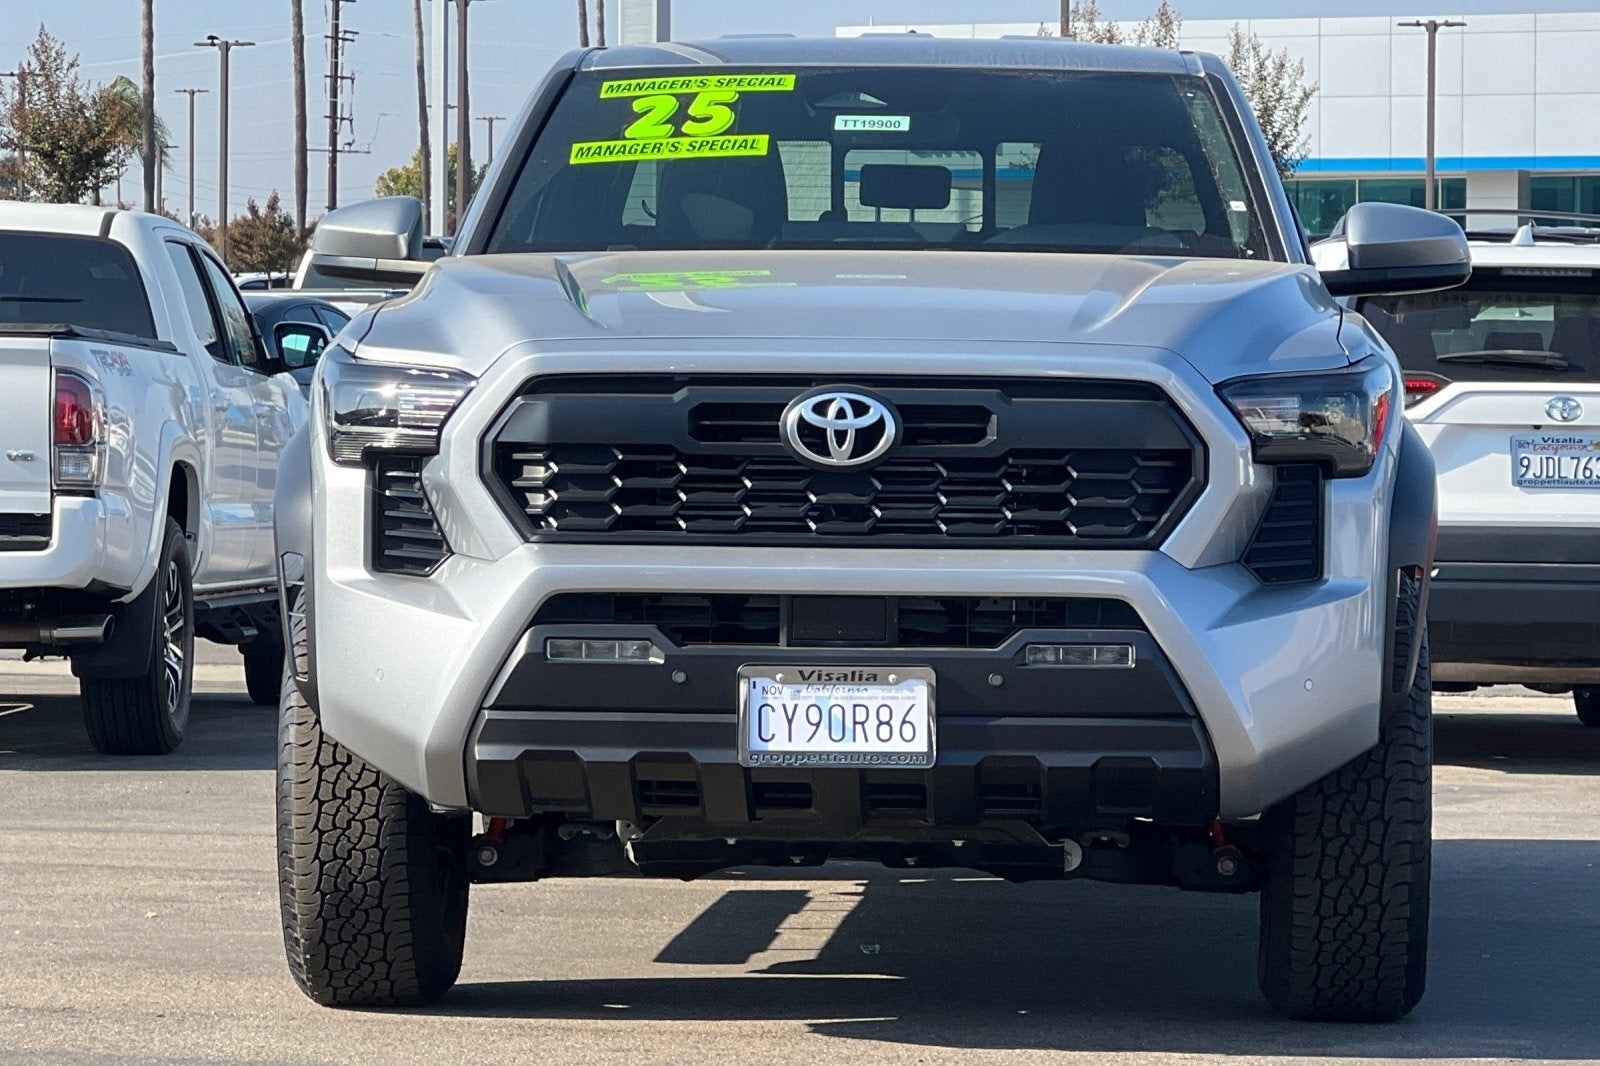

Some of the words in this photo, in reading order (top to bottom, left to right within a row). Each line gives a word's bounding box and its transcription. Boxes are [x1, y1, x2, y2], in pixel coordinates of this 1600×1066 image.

[605, 78, 709, 95] MANAGER'S
[714, 76, 786, 88] SPECIAL
[624, 91, 739, 139] 25
[842, 119, 901, 129] TT19900
[574, 141, 681, 159] MANAGER'S
[686, 139, 759, 153] SPECIAL
[1517, 441, 1530, 449] OCT
[798, 670, 878, 682] Visalia
[761, 685, 784, 695] NOV
[757, 703, 917, 743] CY90R86
